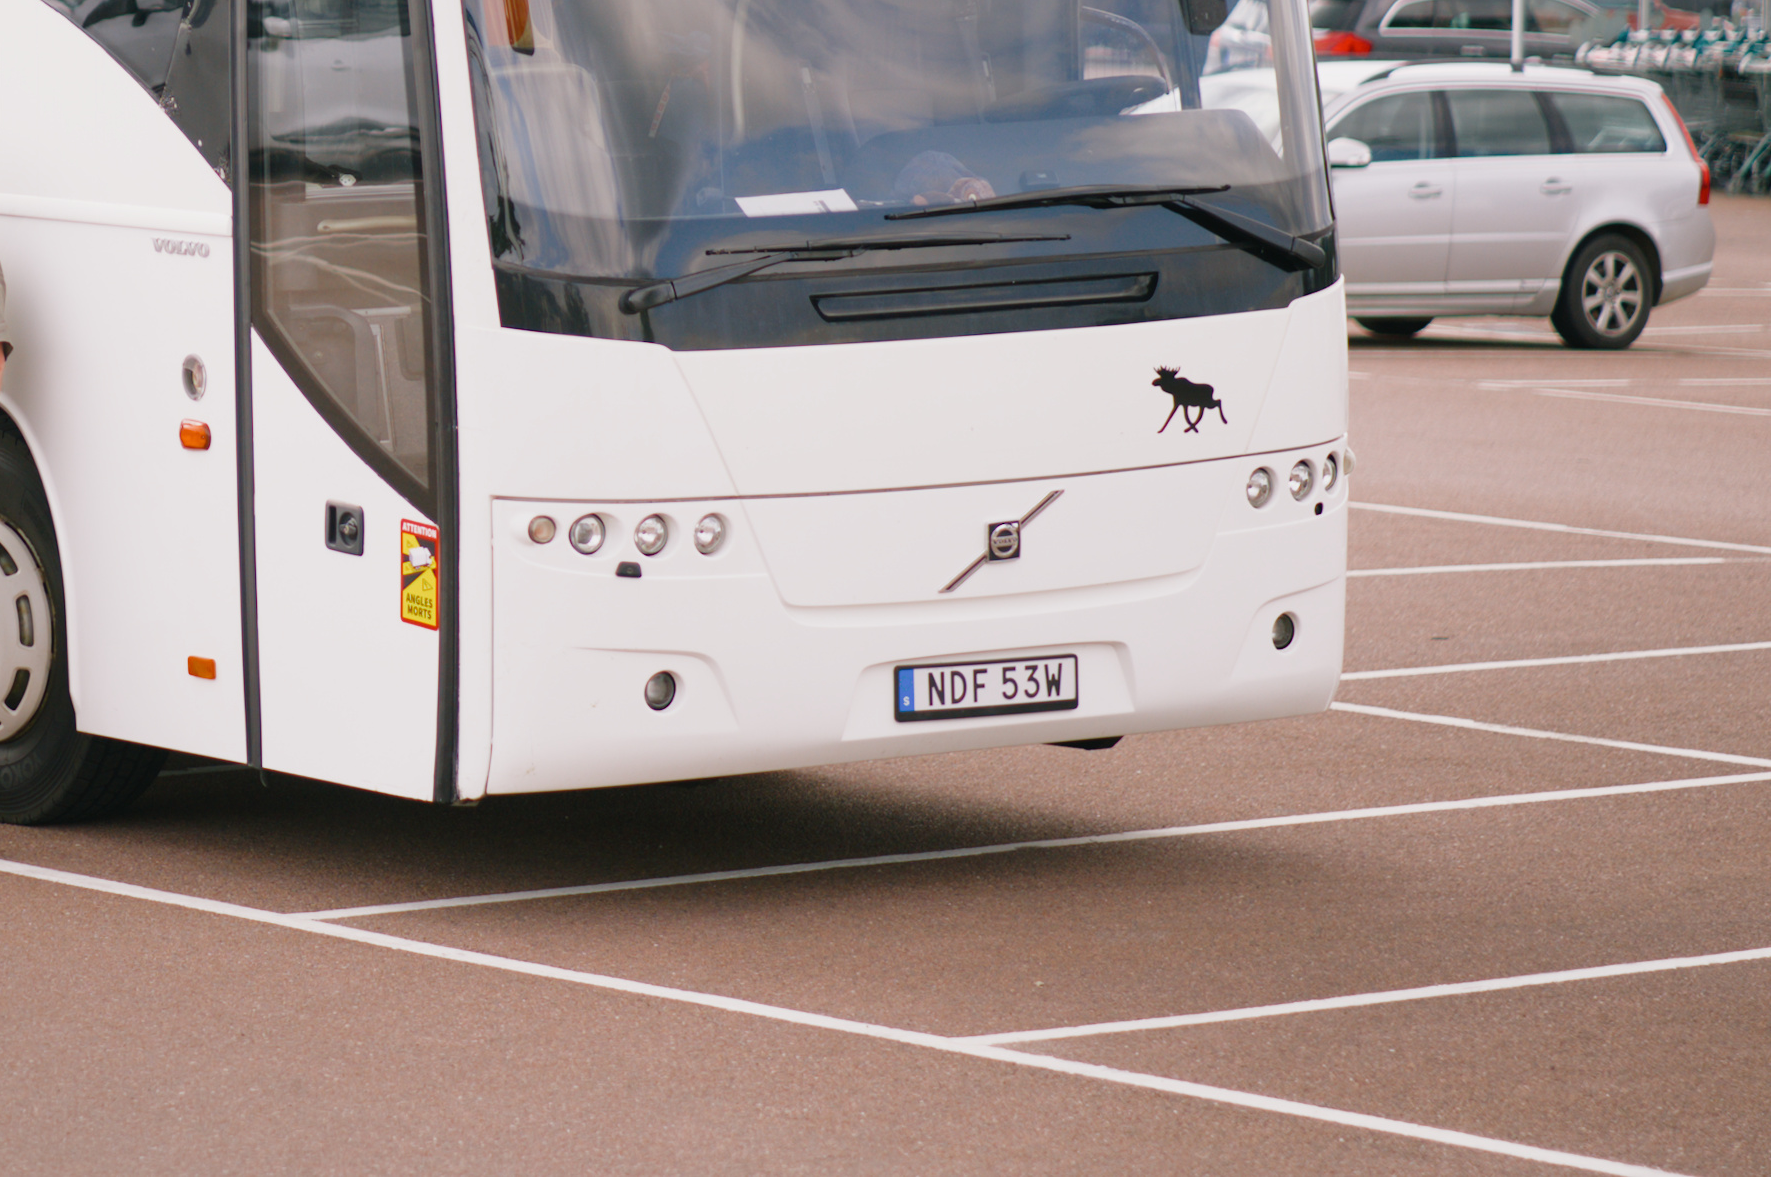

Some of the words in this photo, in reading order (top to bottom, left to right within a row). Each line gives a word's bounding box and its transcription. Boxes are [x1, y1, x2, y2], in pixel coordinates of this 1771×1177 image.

[151, 238, 210, 258] VOLVO
[402, 522, 437, 539] ATTENTION
[406, 593, 432, 609] ANGLES
[407, 604, 431, 620] MORTS
[928, 668, 988, 706] NDF
[1002, 662, 1062, 699] 53W
[903, 696, 910, 706] S
